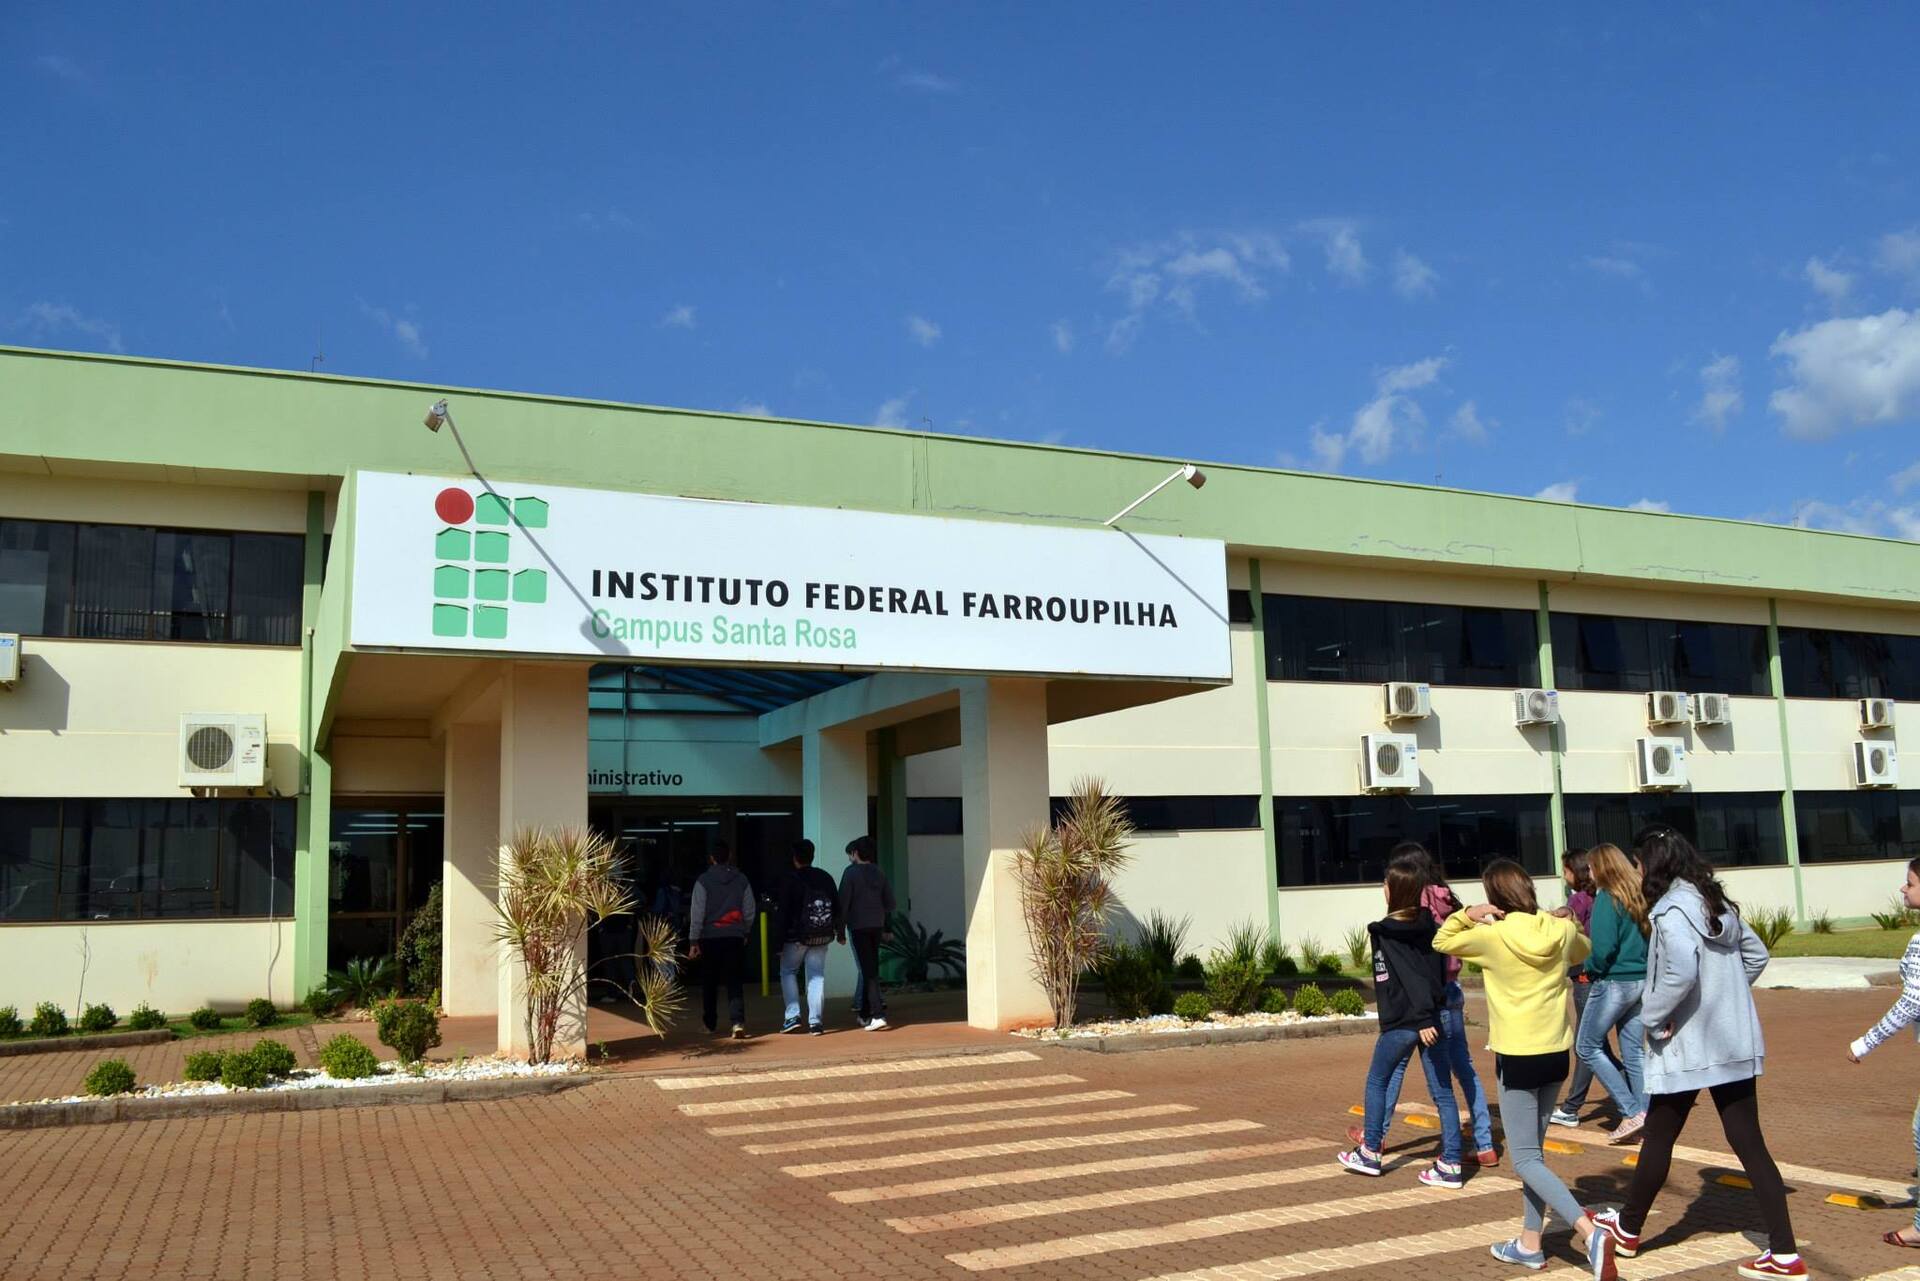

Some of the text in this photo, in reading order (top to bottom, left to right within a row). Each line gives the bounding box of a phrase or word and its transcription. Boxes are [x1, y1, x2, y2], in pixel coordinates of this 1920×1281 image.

[592, 569, 1178, 628] INSTITUTO FEDERAL FARROUPILHA
[592, 608, 857, 649] Campus Santa Rosa
